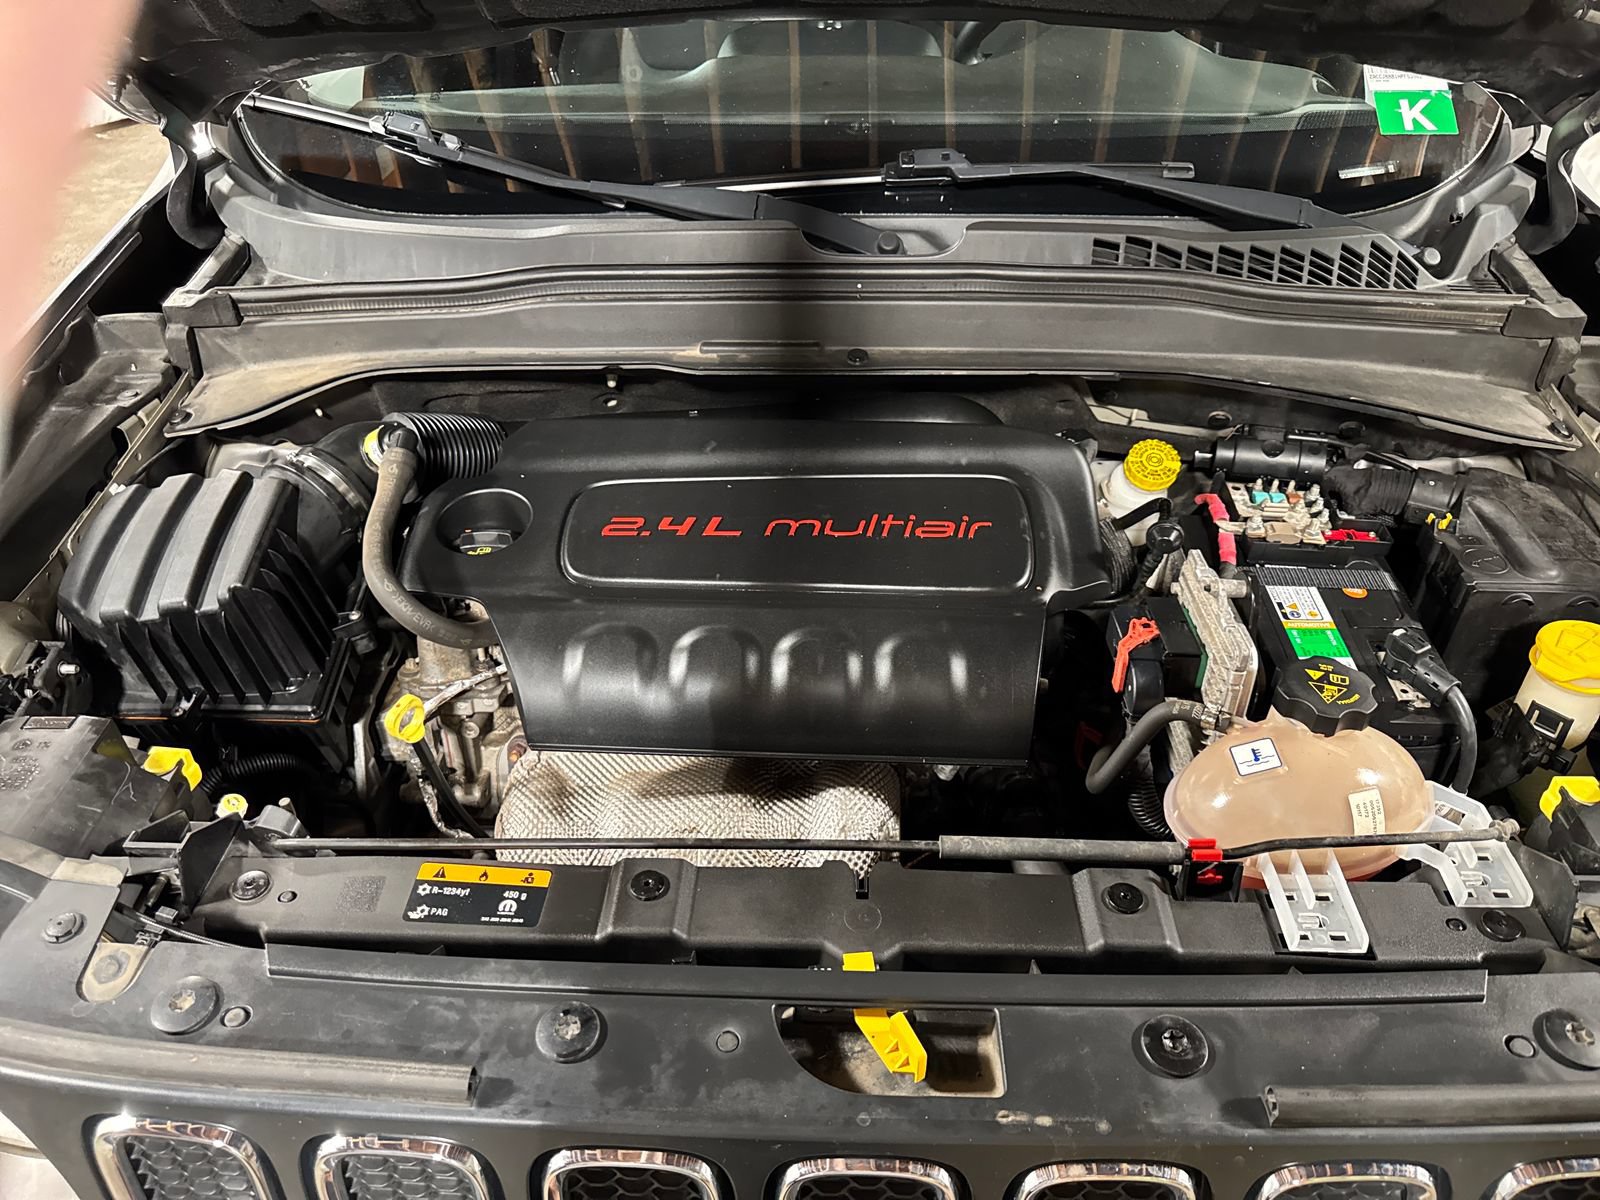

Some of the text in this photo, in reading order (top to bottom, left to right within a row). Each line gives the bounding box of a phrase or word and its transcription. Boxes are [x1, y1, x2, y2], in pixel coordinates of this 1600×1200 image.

[1399, 99, 1438, 131] K
[763, 514, 993, 540] multiair
[431, 886, 470, 896] R-1234yf
[503, 890, 527, 900] 450 g
[430, 908, 448, 917] PAG
